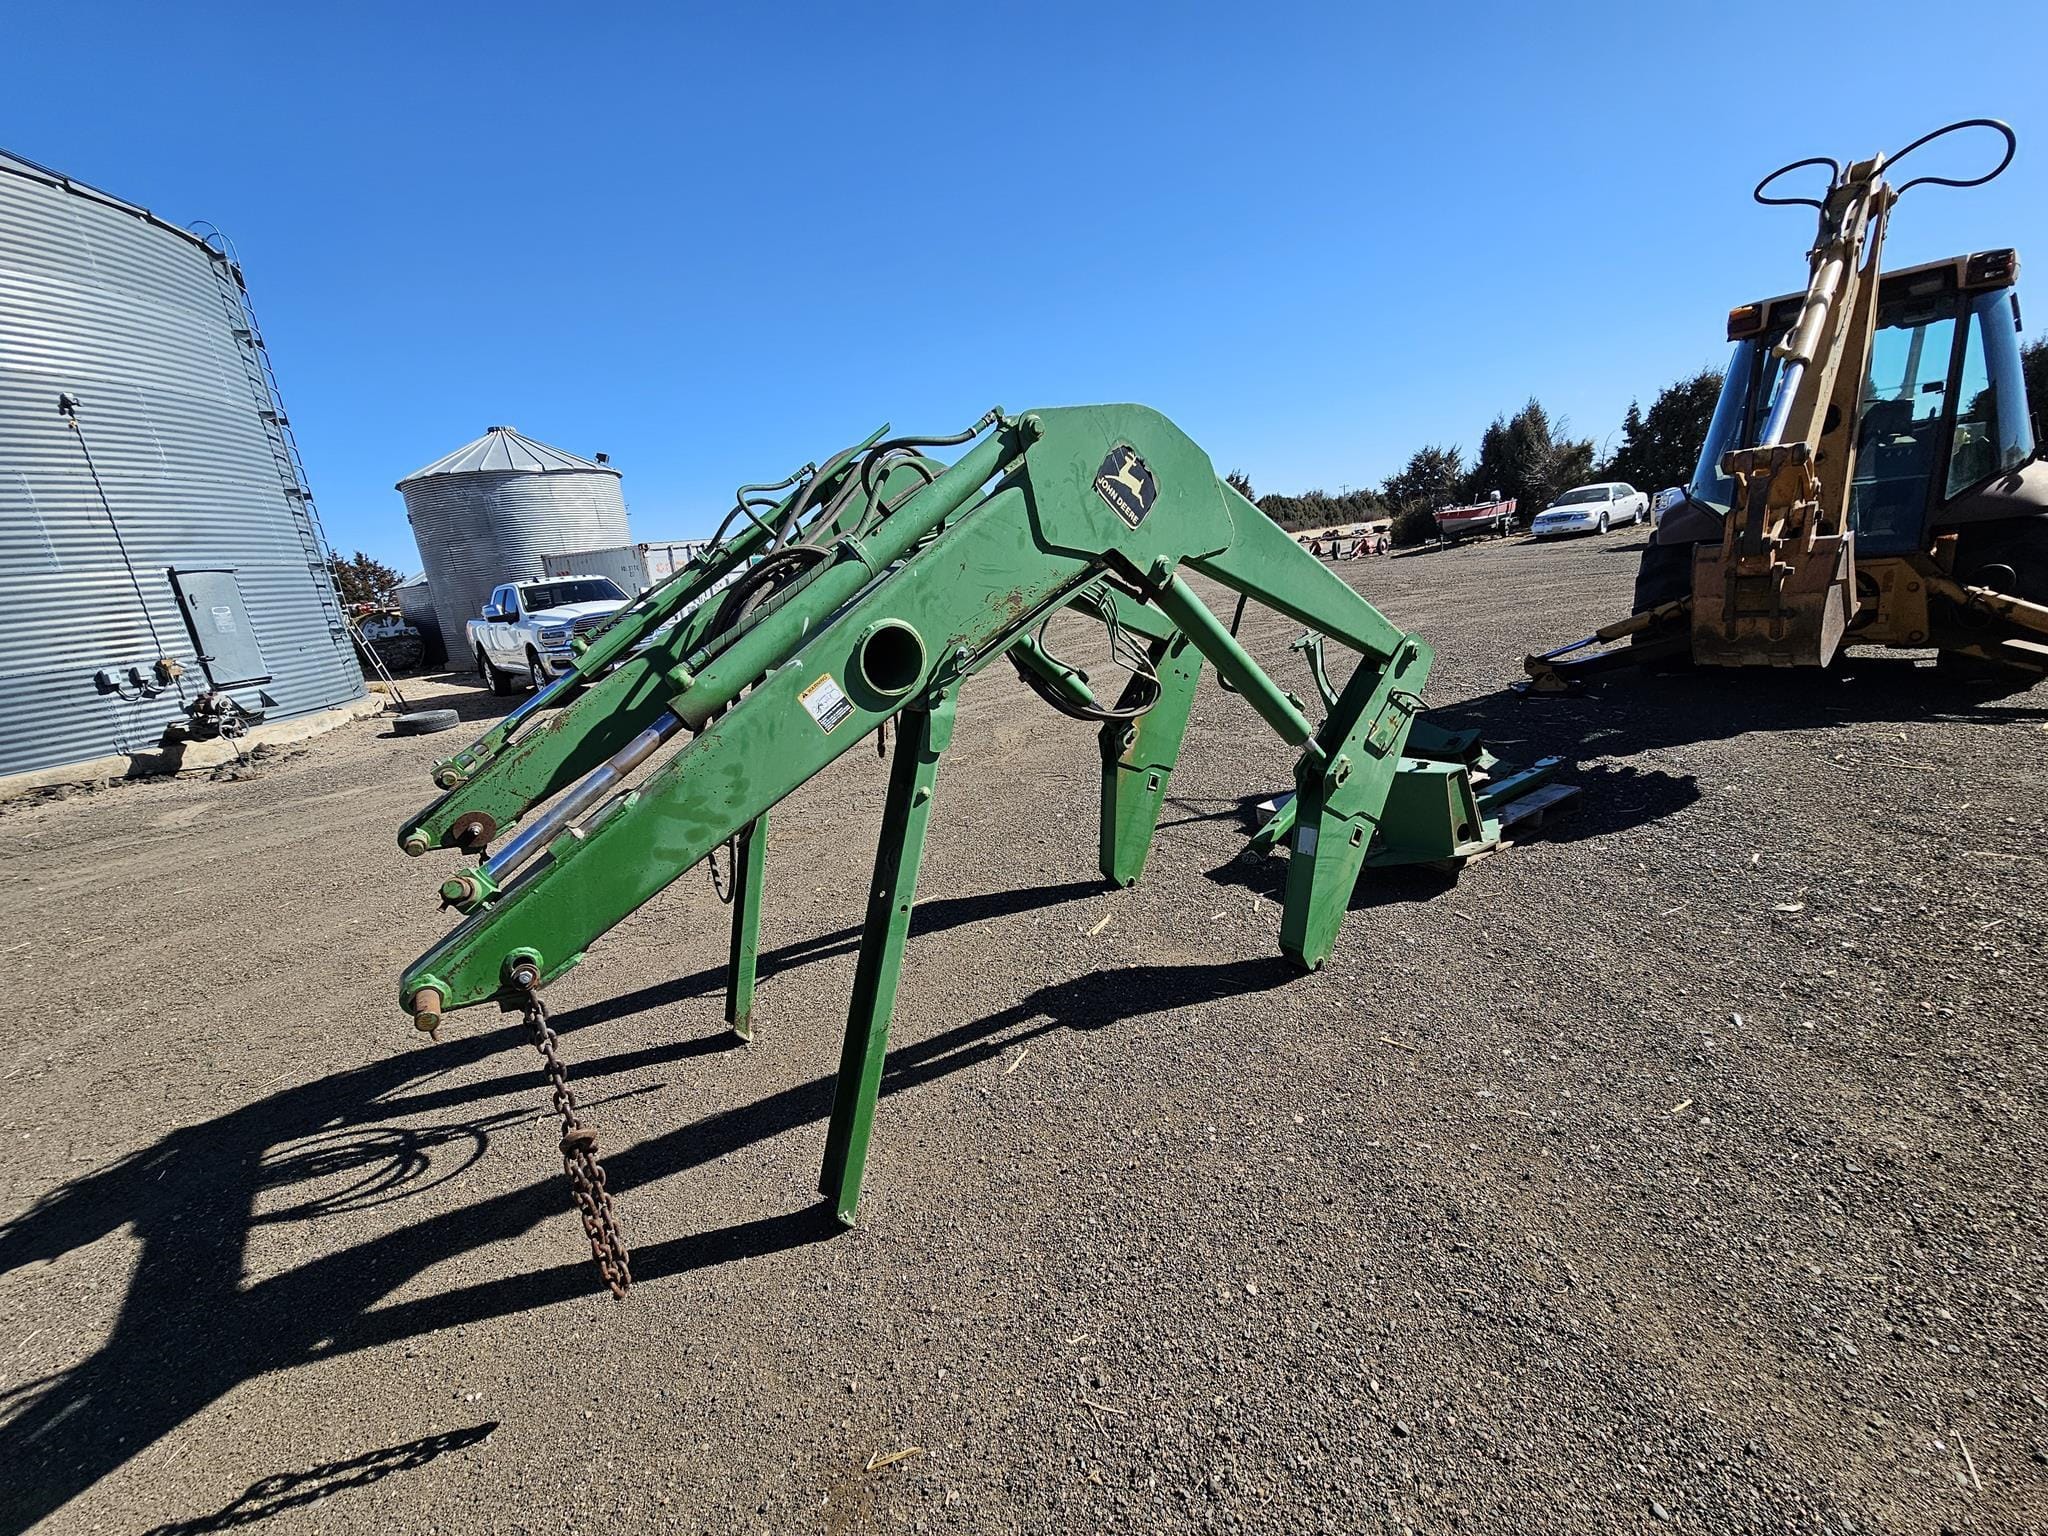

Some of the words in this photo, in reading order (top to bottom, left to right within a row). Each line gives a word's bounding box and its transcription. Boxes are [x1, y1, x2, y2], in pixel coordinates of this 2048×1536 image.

[1098, 477, 1118, 500] JOHN
[1116, 496, 1139, 524] DEERE
[808, 675, 828, 694] WARNING
